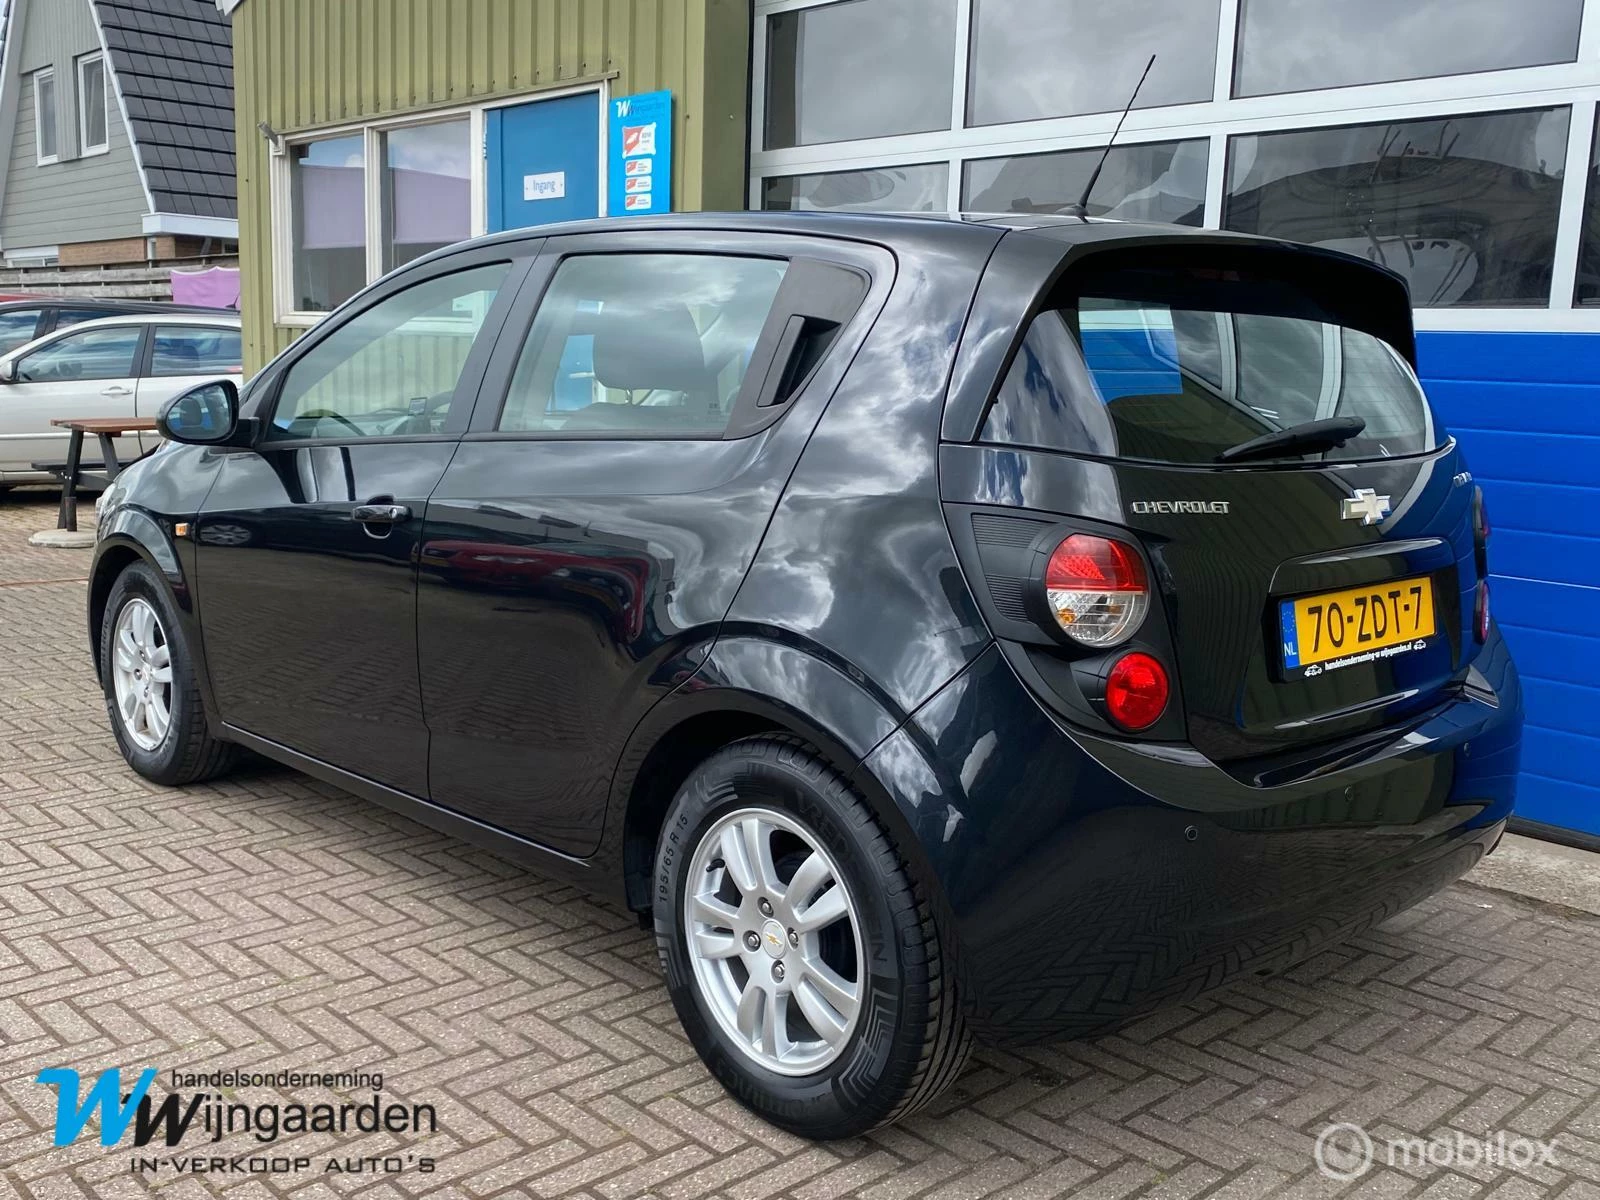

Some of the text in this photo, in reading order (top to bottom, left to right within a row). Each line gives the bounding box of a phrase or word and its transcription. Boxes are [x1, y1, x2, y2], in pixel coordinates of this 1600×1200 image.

[533, 180, 555, 194] Ingang
[1131, 501, 1230, 514] CHEVROLET
[1307, 586, 1422, 653] 70-ZDT-7
[1284, 642, 1297, 657] NL
[659, 814, 688, 901] 195/65 R 15
